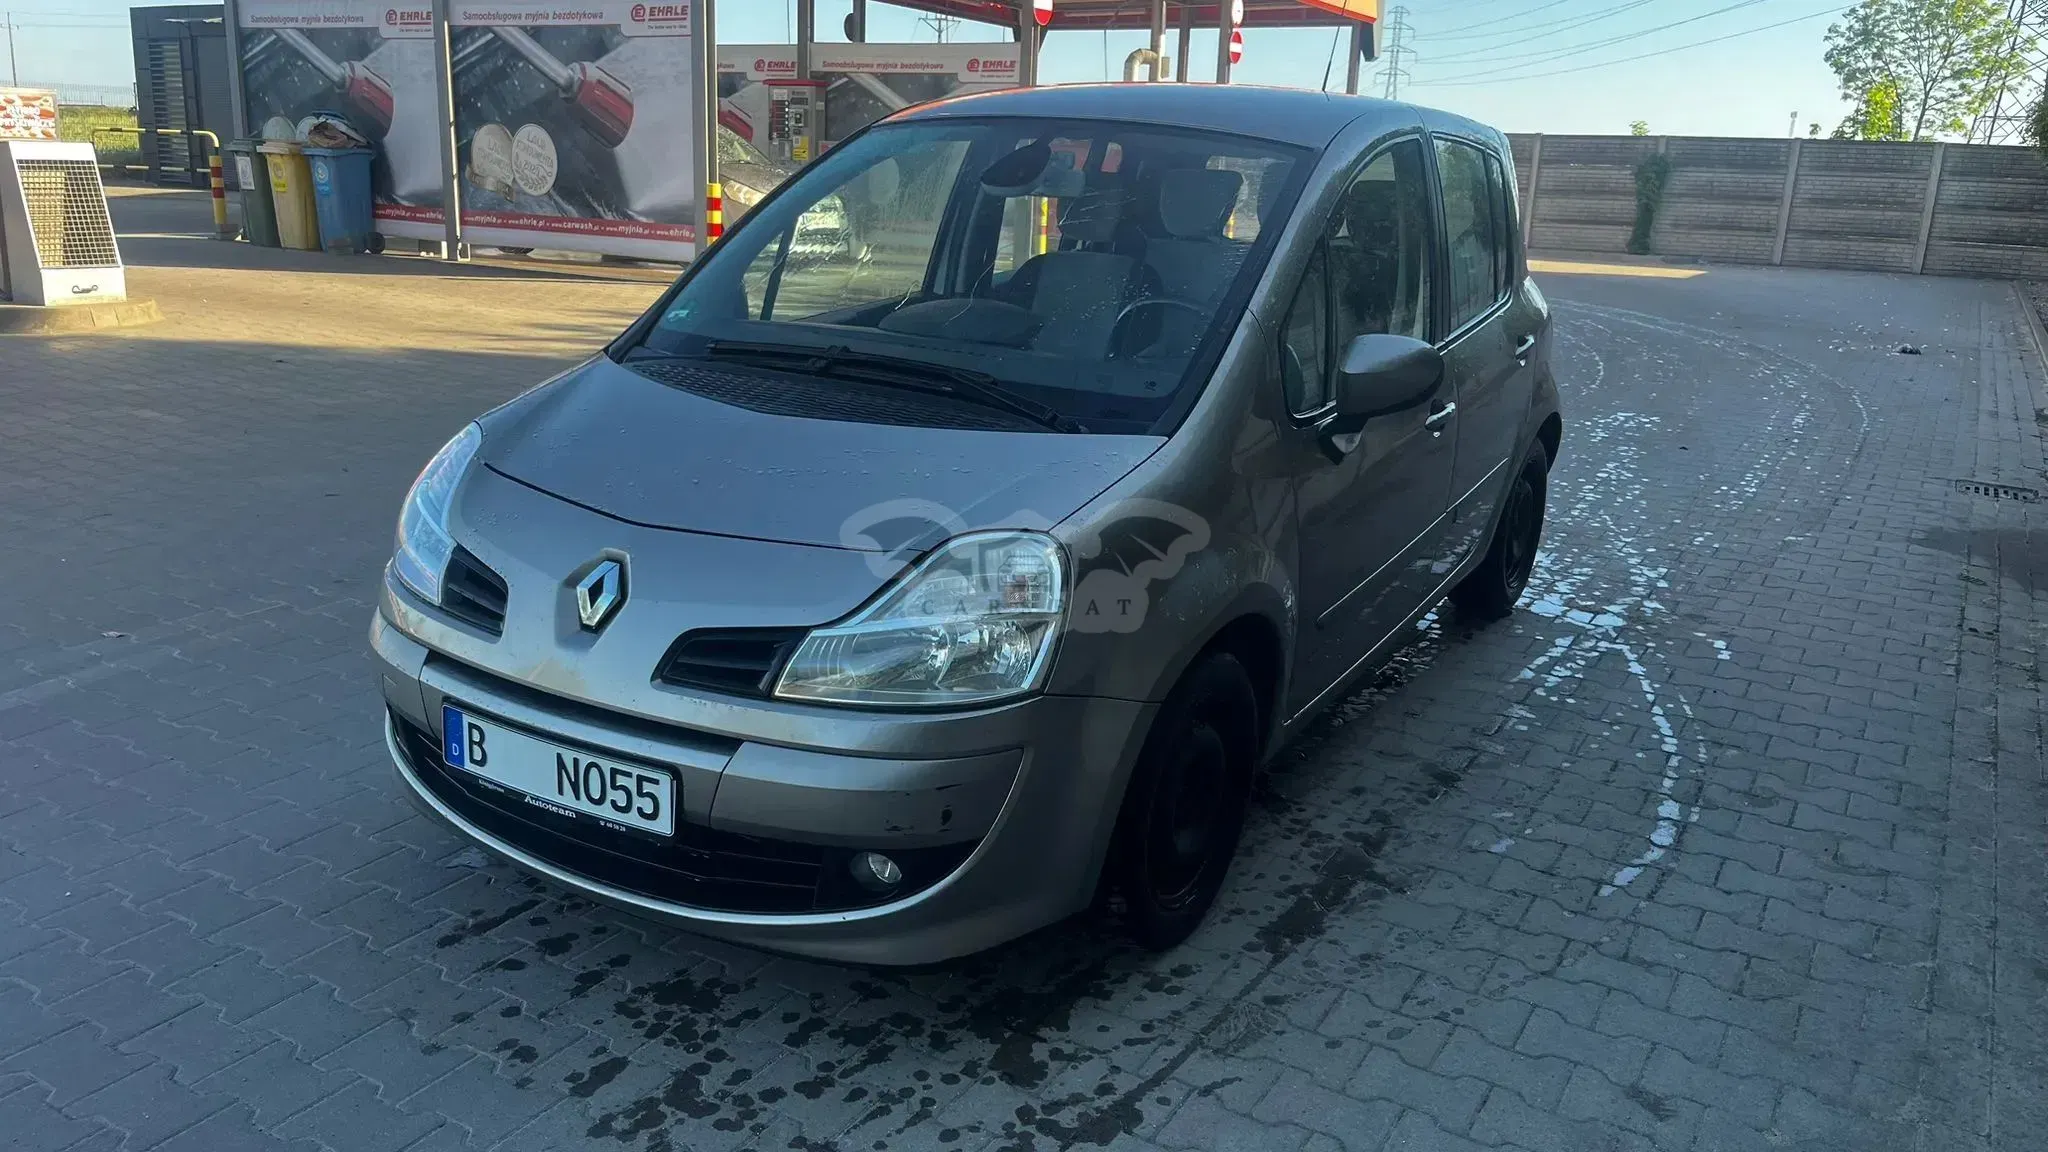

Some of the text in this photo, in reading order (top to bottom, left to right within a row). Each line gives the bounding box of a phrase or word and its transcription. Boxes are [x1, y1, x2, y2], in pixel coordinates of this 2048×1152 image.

[400, 11, 432, 21] EHRLE
[525, 11, 549, 22] myjnia
[552, 9, 604, 21] bezdotykowa
[649, 5, 689, 17] EHRLE
[767, 61, 796, 69] EHRLE
[982, 60, 1016, 69] EHRLE
[452, 743, 460, 756] D
[467, 721, 488, 768] B
[524, 795, 577, 819] Autoteam
